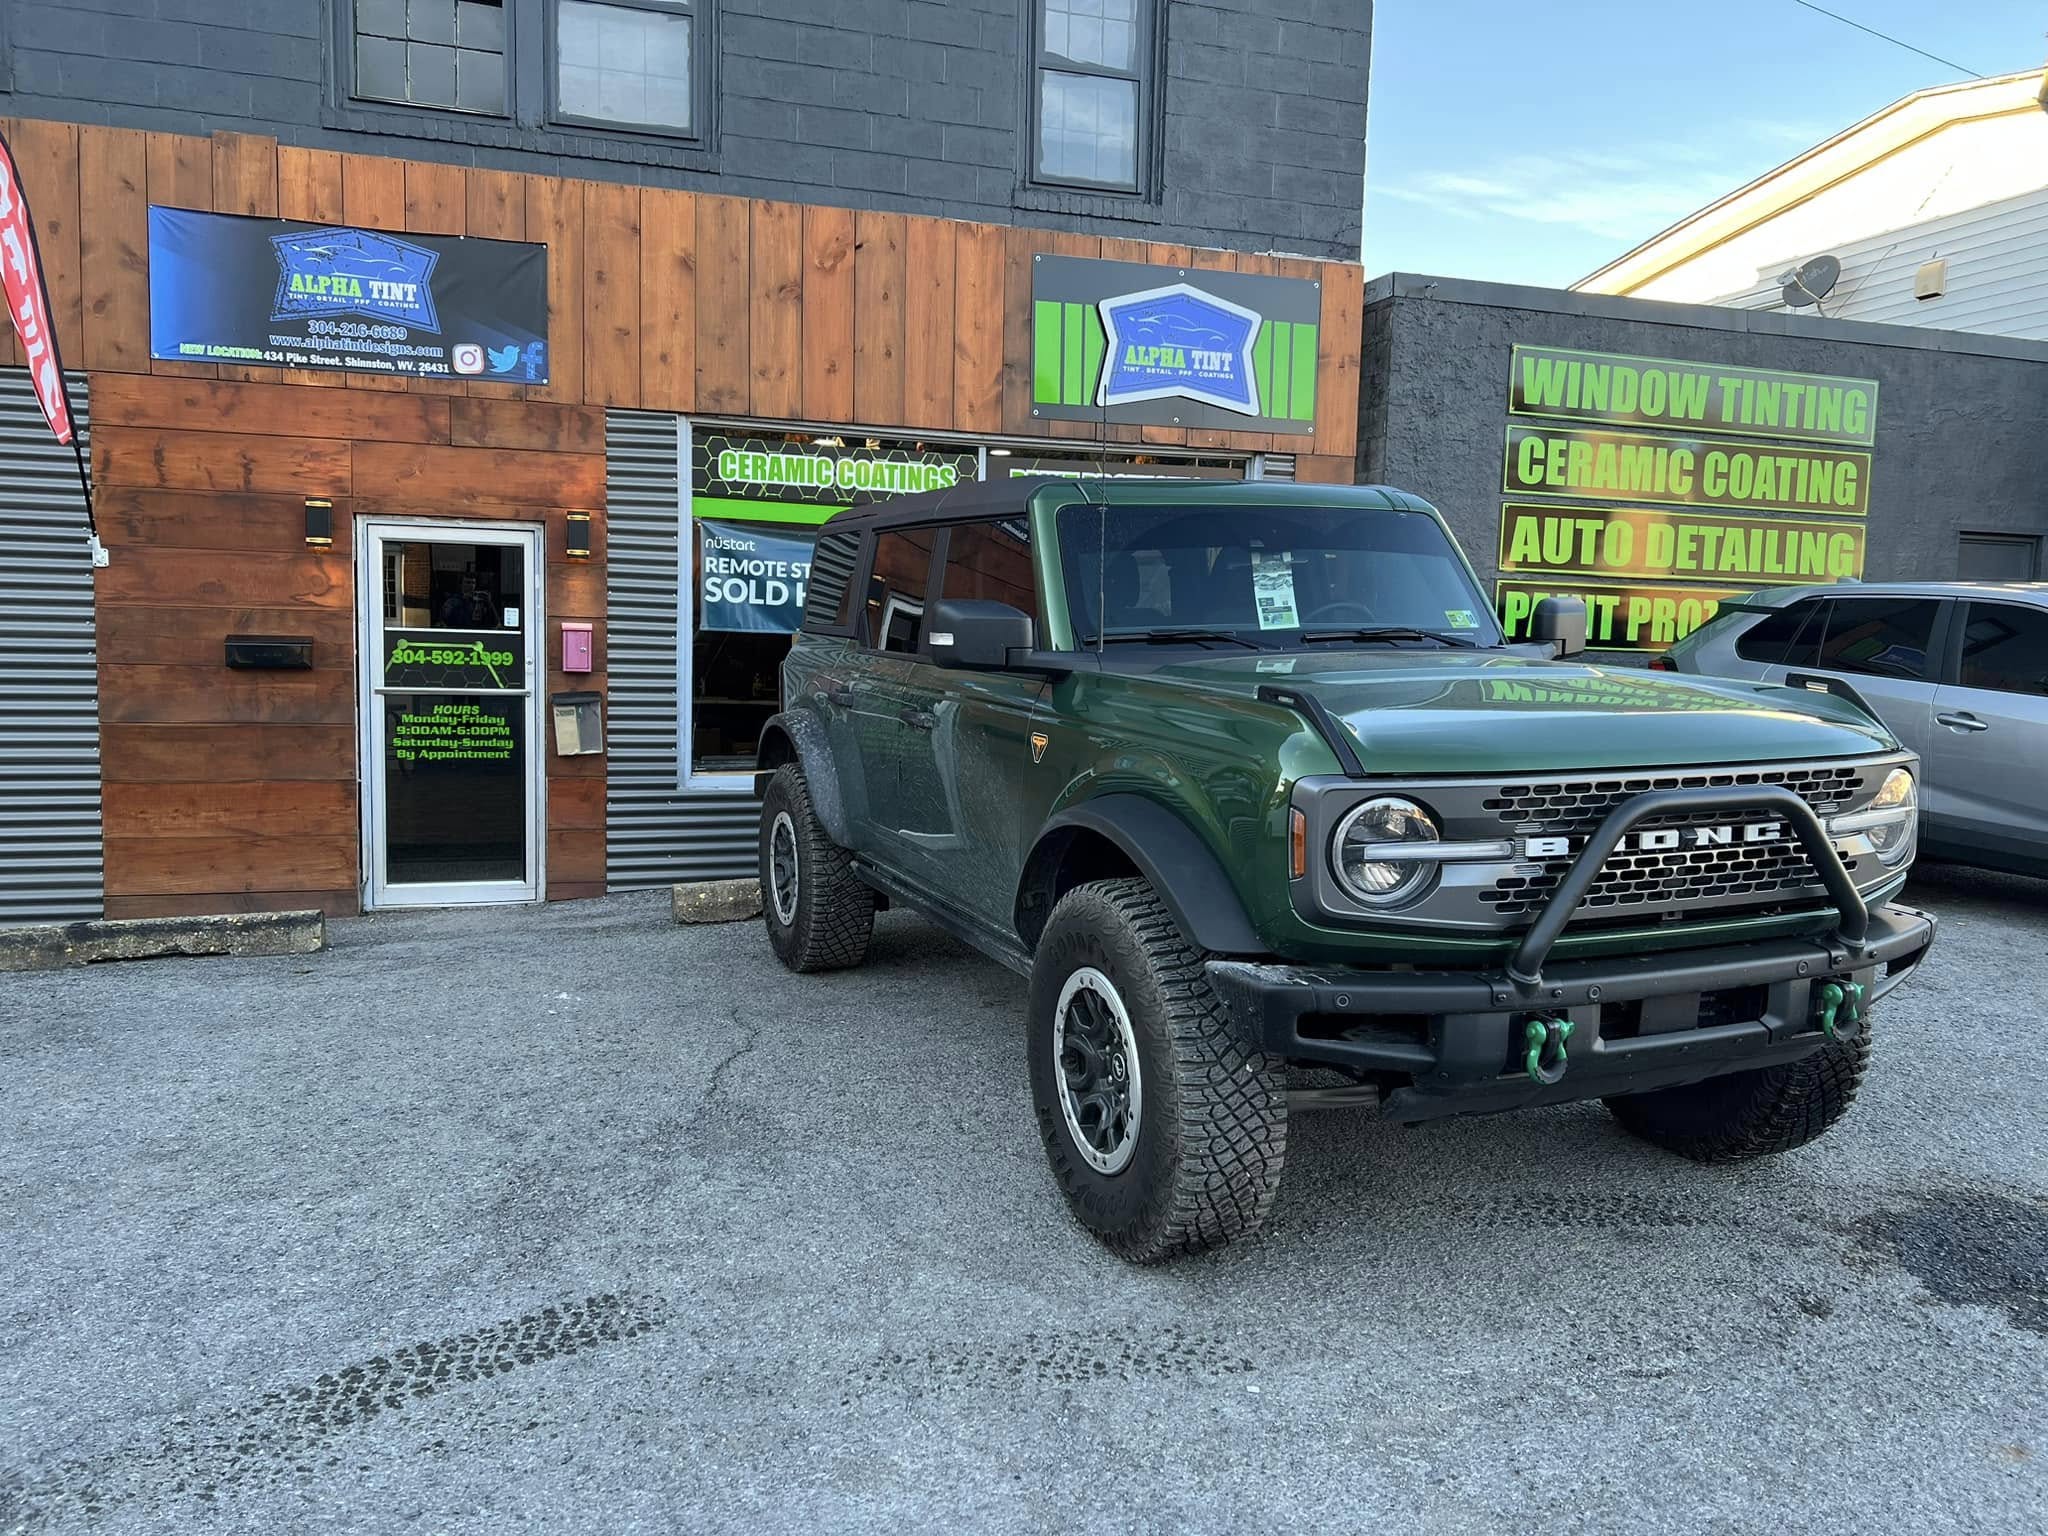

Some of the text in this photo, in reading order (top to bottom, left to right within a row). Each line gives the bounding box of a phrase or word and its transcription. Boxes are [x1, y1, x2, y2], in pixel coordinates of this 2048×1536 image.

[290, 273, 417, 302] ALPHA TINT
[316, 295, 346, 304] DETAIL
[378, 301, 420, 309] COATINGS
[307, 320, 408, 340] 304-216-6689
[269, 334, 444, 358] www.alphatintdesigns.com
[263, 351, 284, 362] 434
[286, 352, 308, 363] Pike
[397, 361, 416, 372] WV.
[418, 362, 449, 373] 26431
[1124, 345, 1232, 371] ALPHA TINT
[1146, 367, 1172, 375] DETAIL
[1522, 357, 1868, 434] WINDOW TINTING
[718, 449, 956, 493] CERAMIC COATINGS
[1517, 436, 1857, 506] CERAMIC COATING
[705, 536, 756, 552] nüstart
[1509, 516, 1856, 578] AUTO DETAILING
[705, 557, 787, 577] REMOTE
[704, 577, 789, 607] SOLD
[391, 649, 513, 666] 304-592-1999
[401, 714, 505, 725] Monday-Friday
[433, 704, 480, 715] HOURS
[396, 726, 510, 736] 9:00AM-6:00PM
[392, 737, 514, 749] Saturday-Sunday
[396, 749, 511, 760] By Appointment
[1525, 820, 1826, 858] BONC
